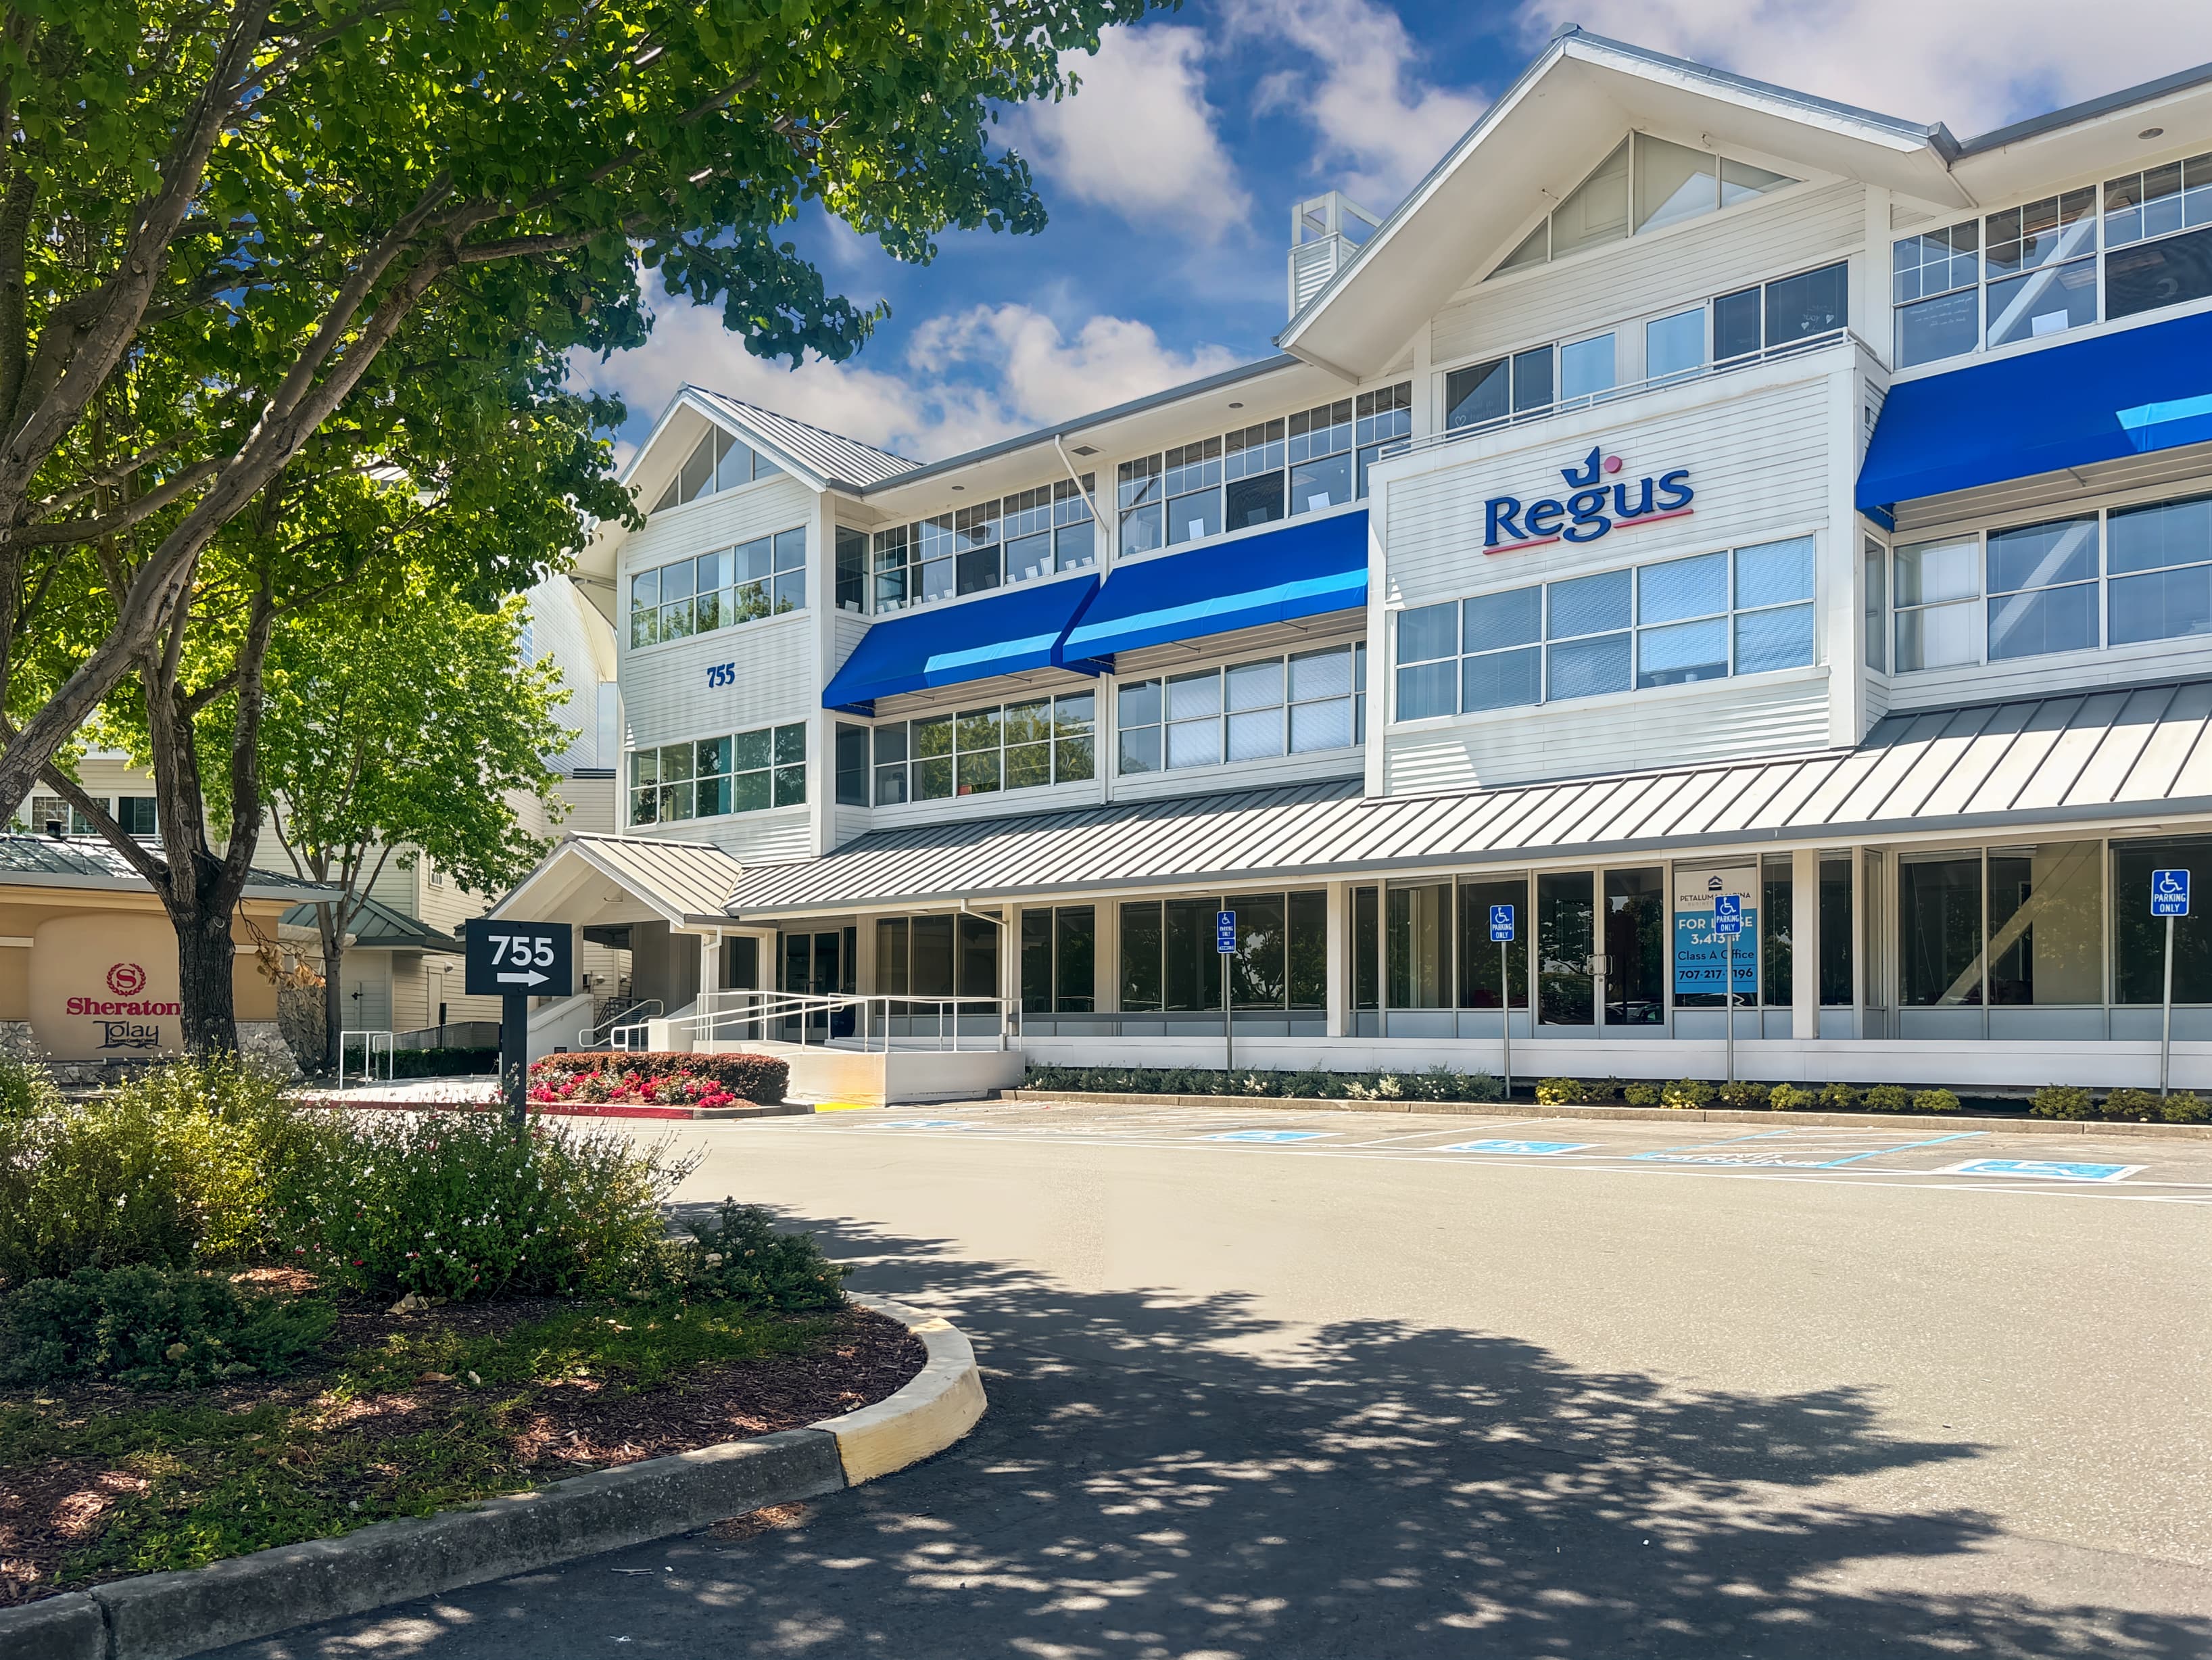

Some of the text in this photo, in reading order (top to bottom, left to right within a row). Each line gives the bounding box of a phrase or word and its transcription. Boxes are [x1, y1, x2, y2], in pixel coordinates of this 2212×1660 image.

[1483, 469, 1695, 544] Regus
[706, 662, 736, 688] 755
[2154, 893, 2186, 903] PARKING
[2160, 904, 2180, 912] ONLY
[1679, 916, 1752, 930] FOR LSE
[1716, 915, 1739, 923] PARKING
[1721, 924, 1735, 932] ONLY
[1691, 933, 1725, 944] 3,413
[487, 934, 555, 967] 755
[1677, 950, 1706, 960] Class
[1709, 949, 1717, 959] A
[66, 997, 181, 1016] Sheraton
[93, 1020, 162, 1049] Tolay
